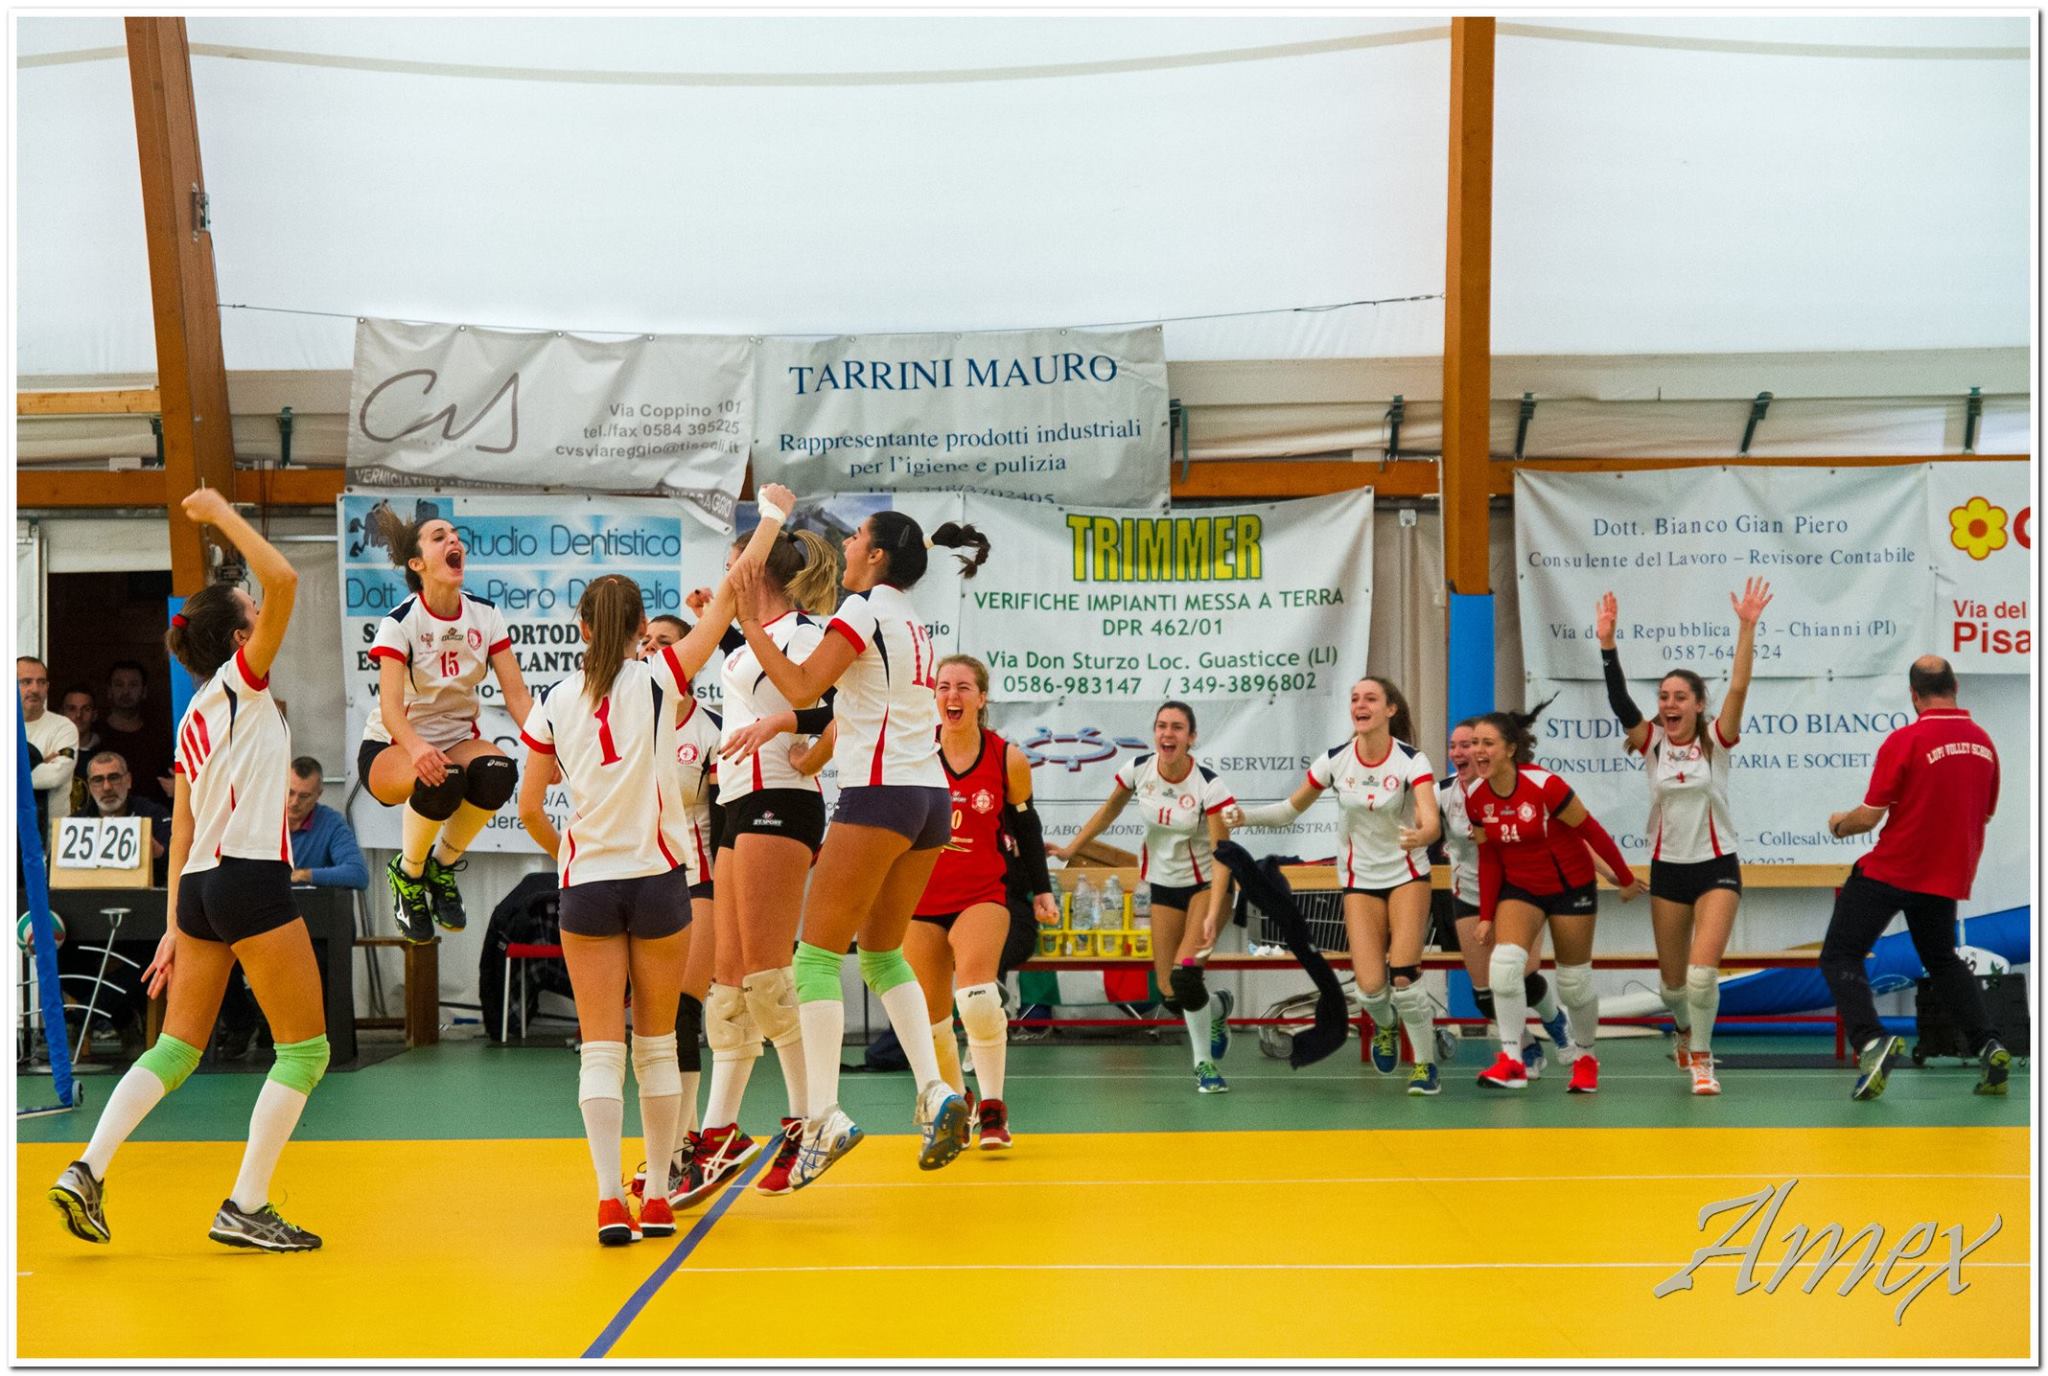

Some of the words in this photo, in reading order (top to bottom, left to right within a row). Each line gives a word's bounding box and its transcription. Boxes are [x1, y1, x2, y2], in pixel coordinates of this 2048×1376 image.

[789, 359, 953, 395] TARRINI
[966, 352, 1118, 387] MAURO
[609, 403, 635, 417] Via
[640, 403, 713, 420] Coppino
[717, 400, 742, 415] 101
[584, 424, 638, 439] tel./fax
[643, 423, 682, 437] 0584
[688, 418, 740, 436] 395225
[779, 430, 939, 456] Rappresentante
[946, 425, 1030, 452] prodotti
[1037, 418, 1142, 444] industriali
[850, 457, 884, 478] per
[889, 454, 970, 478] l'igiene
[976, 459, 987, 472] e
[994, 453, 1067, 476] pulizia
[1593, 517, 1645, 537] Dott.
[1655, 516, 1728, 535] Bianco
[1735, 514, 1784, 534] Gian
[1795, 515, 1849, 534] Piero
[456, 525, 538, 557] Studio
[551, 524, 681, 557] Dentistico
[1066, 513, 1263, 582] TRIMMER
[1528, 550, 1629, 568] Consulente
[1635, 551, 1662, 567] del
[1668, 550, 1728, 566] Lavoro
[1749, 549, 1823, 566] Revisore
[1830, 547, 1916, 565] Contabile
[487, 578, 556, 610] Piero
[974, 591, 1080, 611] VERIFICHE
[1087, 592, 1176, 611] IMPIANTI
[1185, 591, 1250, 611] MESSA
[1259, 591, 1272, 609] A
[1279, 587, 1344, 608] TERRA
[1953, 599, 1988, 618] Via
[1994, 601, 2027, 619] del
[507, 623, 580, 645] ORTOD
[1103, 619, 1143, 637] DPR
[1151, 618, 1223, 637] 462/01
[1550, 623, 1576, 640] Via
[1633, 621, 1730, 642] Repubblica
[1789, 620, 1861, 638] Chianni
[1868, 619, 1897, 639] (PI)
[1953, 621, 2031, 654] Pisa
[440, 650, 460, 678] 15
[987, 650, 1018, 669] Via
[1027, 650, 1065, 669] Don
[1073, 651, 1140, 671] Sturzo
[1148, 652, 1189, 671] Loc.
[1199, 649, 1301, 669] Guasticce
[1307, 646, 1338, 669] (LI)
[1004, 675, 1142, 695] 0586-983147
[1180, 672, 1317, 695] 349-3896802
[593, 695, 623, 767] 1
[1546, 718, 1622, 740] STUDI
[1806, 712, 1909, 734] BIANCO
[1220, 756, 1294, 771] SERVIZI
[1538, 756, 1646, 773] CONSULENZ
[1788, 753, 1800, 769] E
[1367, 793, 1375, 812] 7
[951, 809, 963, 830] 0
[1158, 806, 1172, 826] 11
[62, 824, 95, 860] 25
[100, 825, 134, 861] 26
